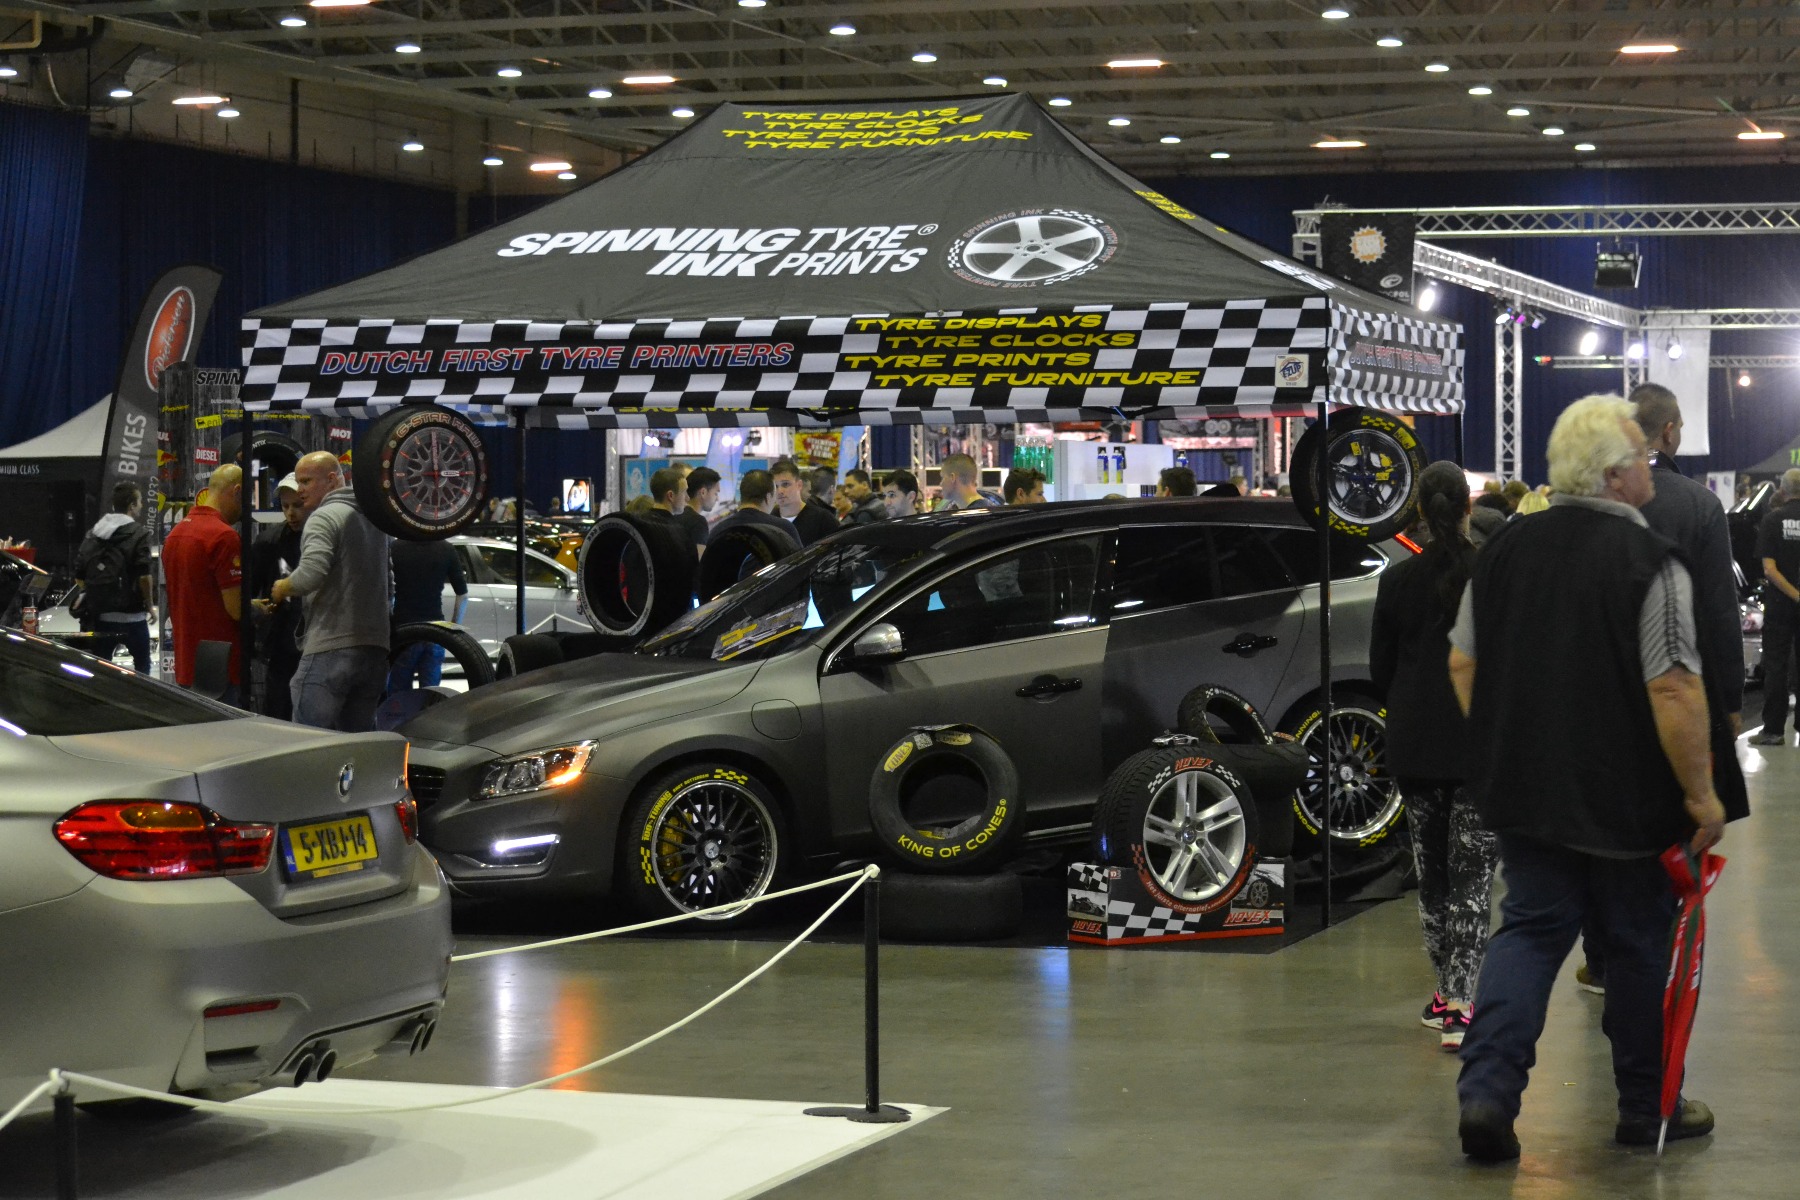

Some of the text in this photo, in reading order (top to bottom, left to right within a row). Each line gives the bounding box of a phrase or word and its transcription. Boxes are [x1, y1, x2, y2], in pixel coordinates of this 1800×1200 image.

[742, 107, 960, 121] TYRE DISPLAYS
[763, 113, 984, 130] TYRE CLOCKS
[722, 126, 941, 140] TYRE PRINTS
[744, 130, 1034, 150] TYRE FURNITURE
[962, 208, 1045, 239] SPINNING INK
[497, 228, 802, 257] SPINNING
[646, 246, 928, 277] INK PRINTS
[855, 314, 1103, 331] TYRE DISPLAYS
[885, 333, 1135, 349] TYRE CLOCKS
[320, 342, 795, 375] DUTCH FIRST TYRE PRINTERS
[844, 352, 1092, 369] TYRE PRINTS
[874, 371, 1201, 387] TYRE FURNITURE
[207, 416, 221, 427] eni
[397, 413, 481, 448] G-STAR RAW
[118, 413, 147, 475] BIKES
[196, 449, 218, 462] DIESEL
[20, 465, 40, 475] CLASS
[1175, 757, 1213, 773] NOVEX
[650, 790, 673, 819] TUNING
[299, 823, 368, 863] 5-XBJ-14
[897, 835, 934, 857] KING
[939, 845, 961, 858] OF
[1223, 909, 1271, 926] NOVEX
[1072, 919, 1102, 934] NOVEX
